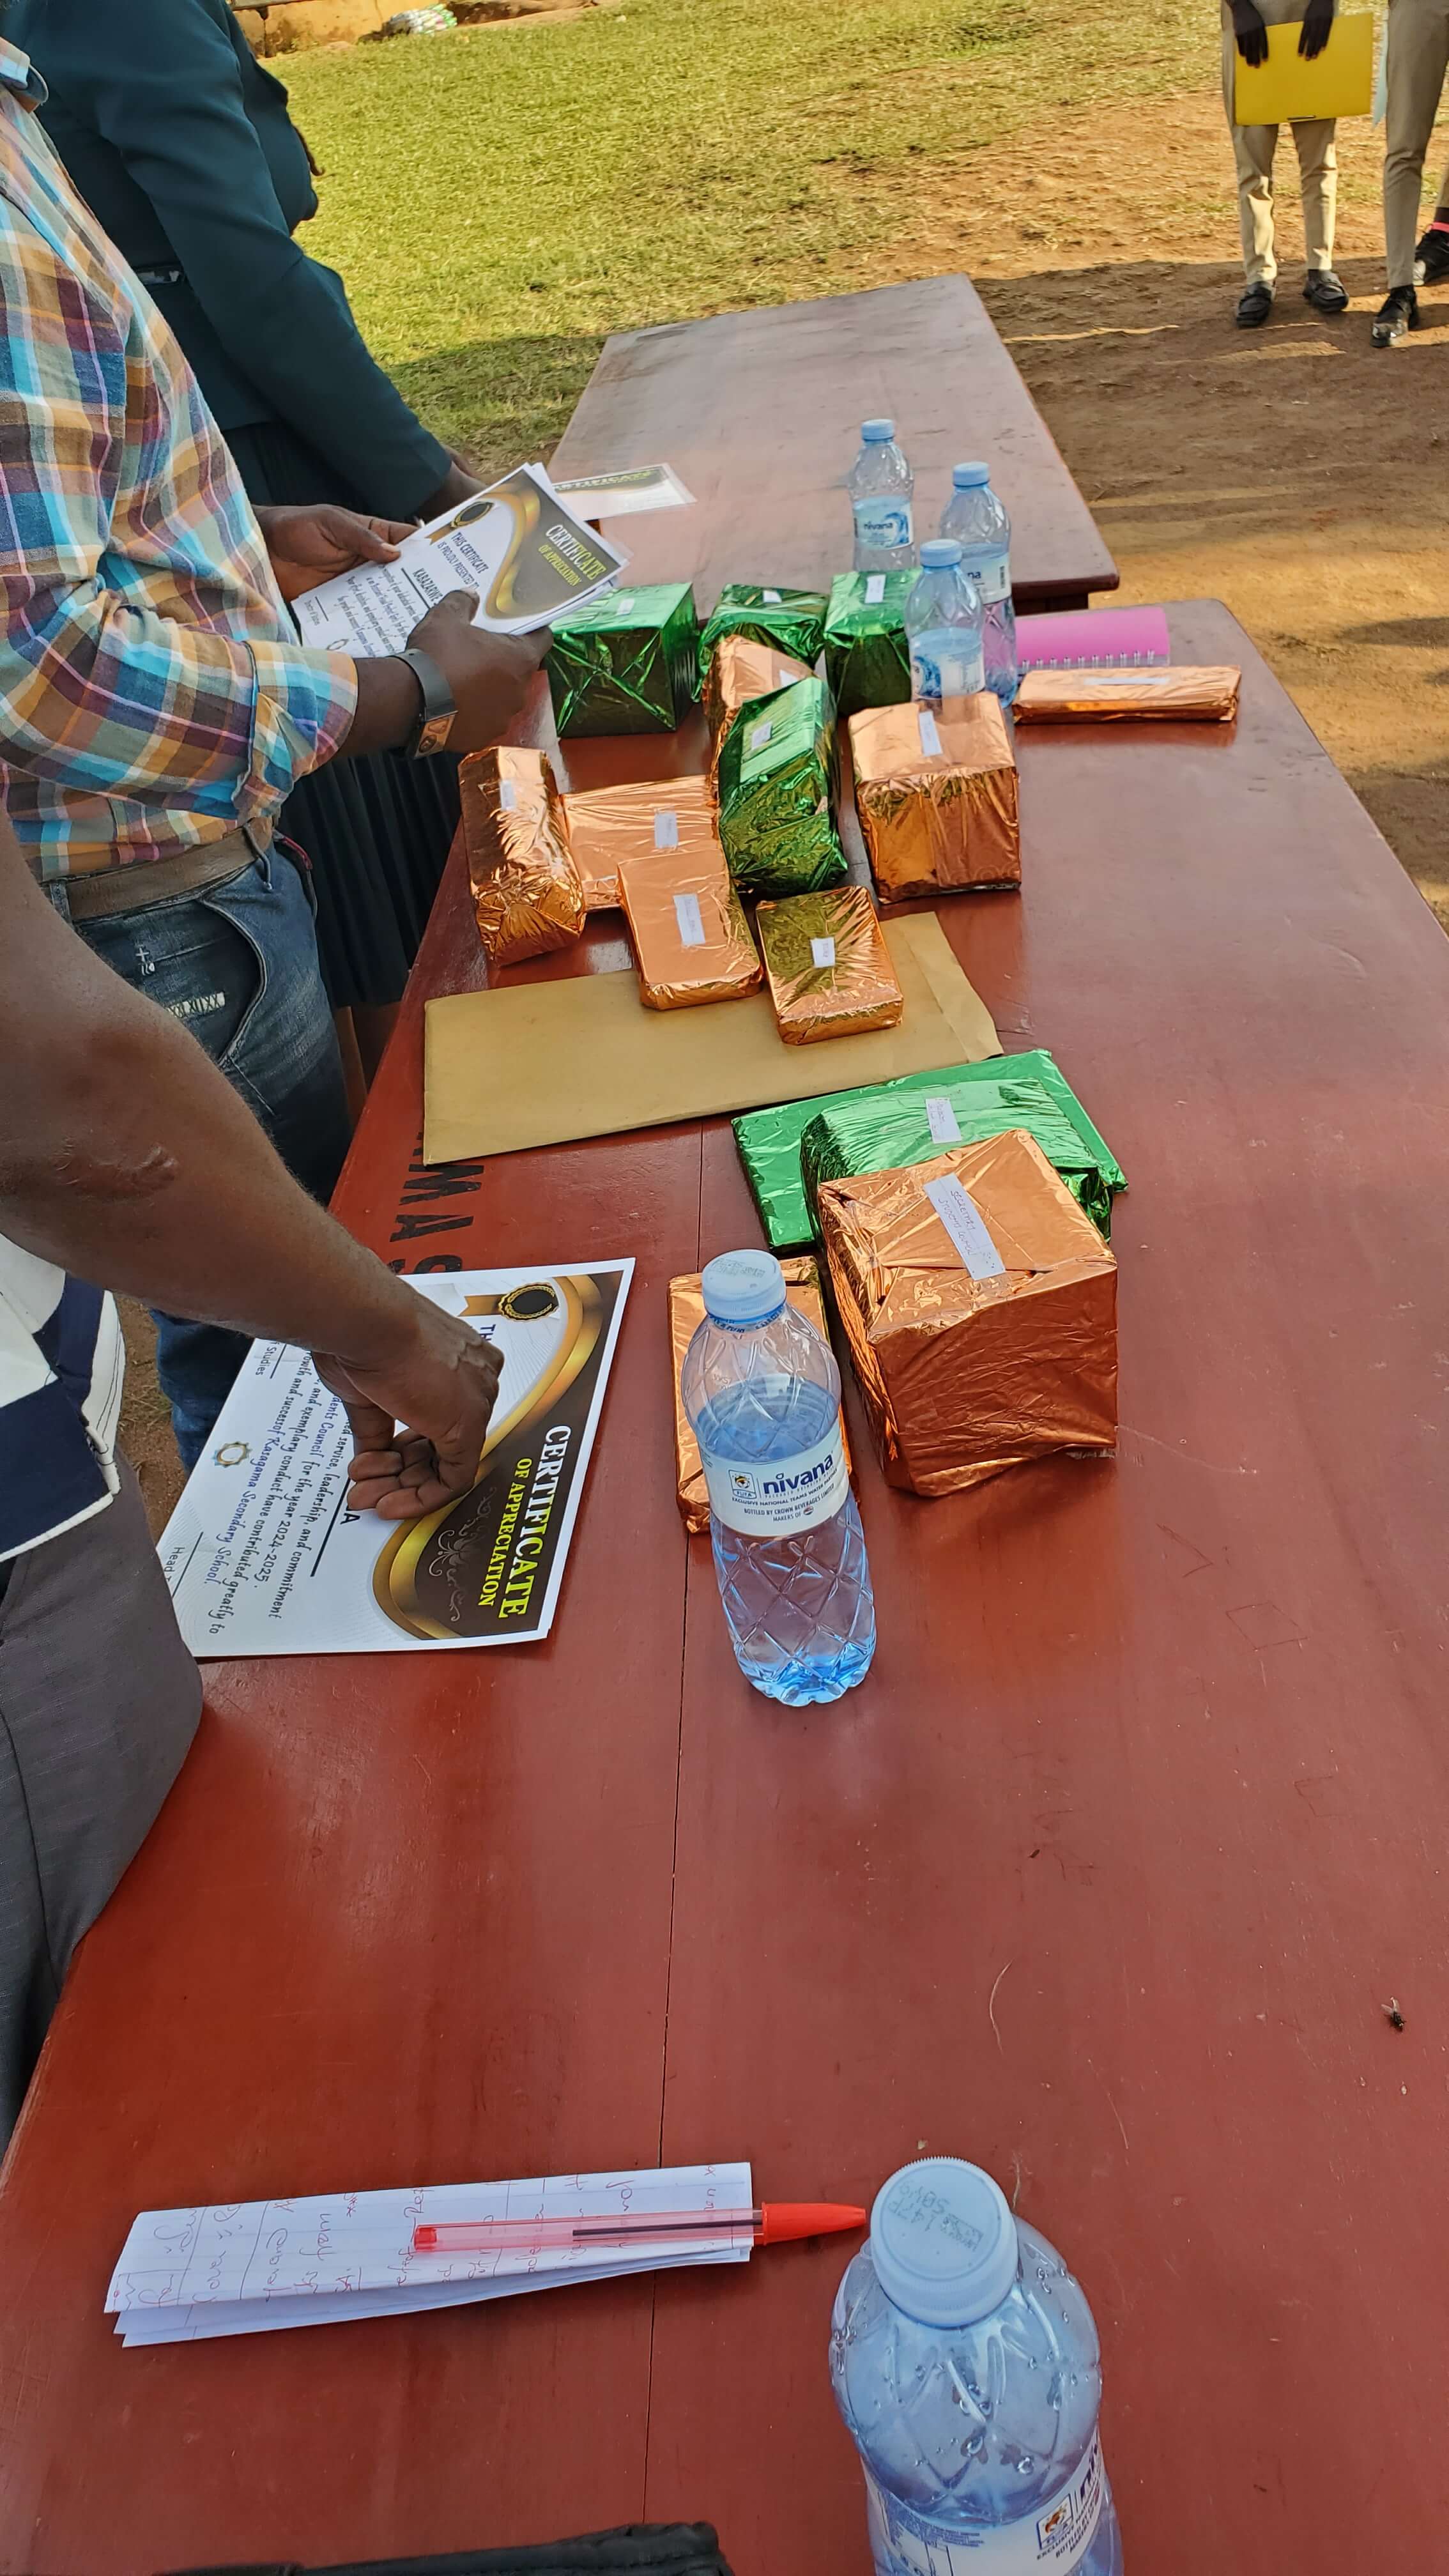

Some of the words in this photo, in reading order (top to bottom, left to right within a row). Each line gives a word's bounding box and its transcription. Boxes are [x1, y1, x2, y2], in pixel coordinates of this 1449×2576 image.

[450, 532, 466, 547] THIS
[459, 542, 489, 574] CERTIFICATE
[546, 525, 606, 580] CERTIFICATE
[256, 1347, 277, 1375] Studies
[288, 1377, 303, 1397] and
[308, 1388, 322, 1406] and
[280, 1406, 313, 1452] exemplary
[310, 1422, 335, 1458] Council
[247, 1437, 280, 1487] Kasagama
[302, 1460, 320, 1475] for
[326, 1436, 348, 1470] service,
[515, 1458, 532, 1478] OF
[270, 1455, 293, 1492] conduct
[294, 1478, 312, 1493] the
[763, 1454, 833, 1494] nivana
[259, 1494, 282, 1517] have
[284, 1493, 301, 1518] year
[300, 1474, 341, 1525] leadership,
[732, 1497, 758, 1506] EXCLUSIVE
[790, 1492, 808, 1503] TEAMS
[808, 1483, 824, 1496] WATER
[794, 1496, 821, 1511] BEVERAGES
[821, 1482, 835, 1500] LIMITED
[215, 1491, 256, 1543] Secondary
[498, 1425, 571, 1618] CERTIFICATE
[772, 1514, 794, 1522] MAKERS
[233, 1519, 266, 1581] contributed
[296, 1529, 312, 1551] and
[479, 1482, 526, 1606] APPRECIATION
[164, 1547, 185, 1572] Head
[204, 1547, 232, 1585] School.
[208, 1577, 239, 1620] greatly
[268, 1551, 302, 1619] commitment
[209, 1623, 225, 1634] to
[299, 2213, 337, 2260] from
